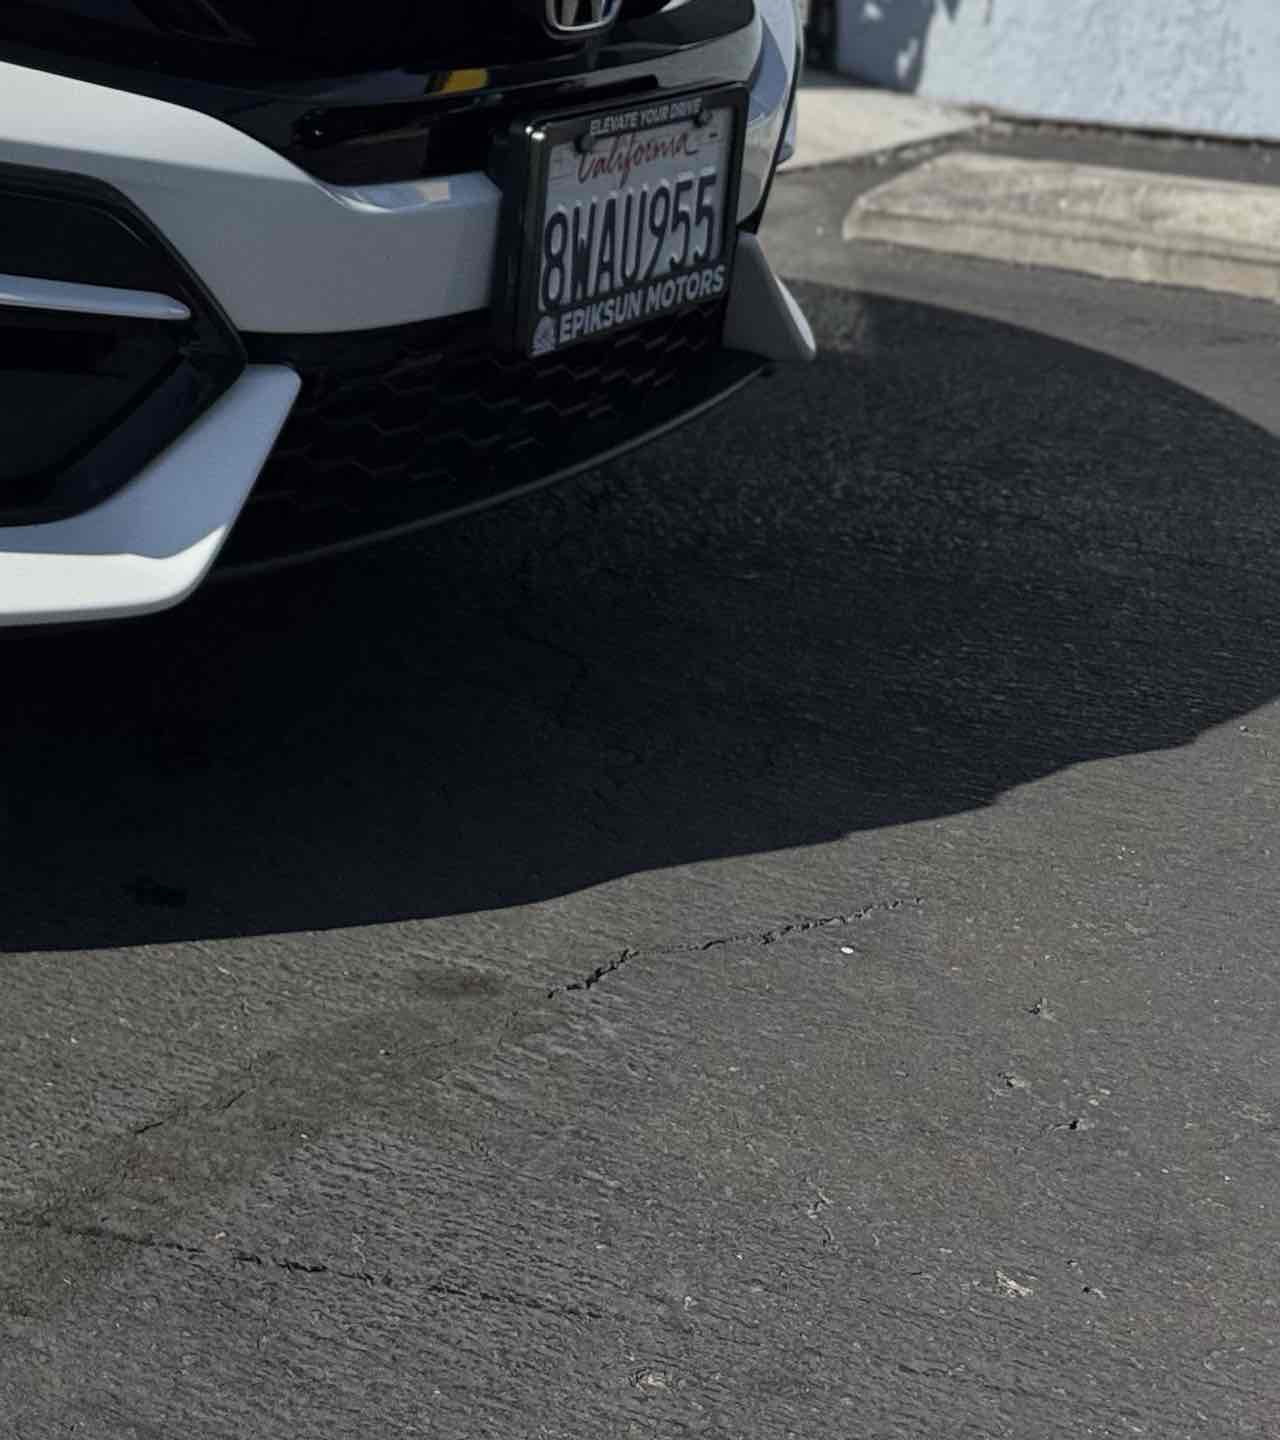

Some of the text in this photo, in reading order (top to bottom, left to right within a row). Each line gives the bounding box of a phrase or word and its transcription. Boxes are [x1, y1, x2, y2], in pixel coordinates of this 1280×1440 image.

[590, 111, 638, 135] ELEVATE
[640, 104, 671, 126] YOUR
[576, 131, 700, 189] California
[542, 172, 718, 310] 8WAU955
[559, 264, 726, 344] EPIKSUN MOTORS
